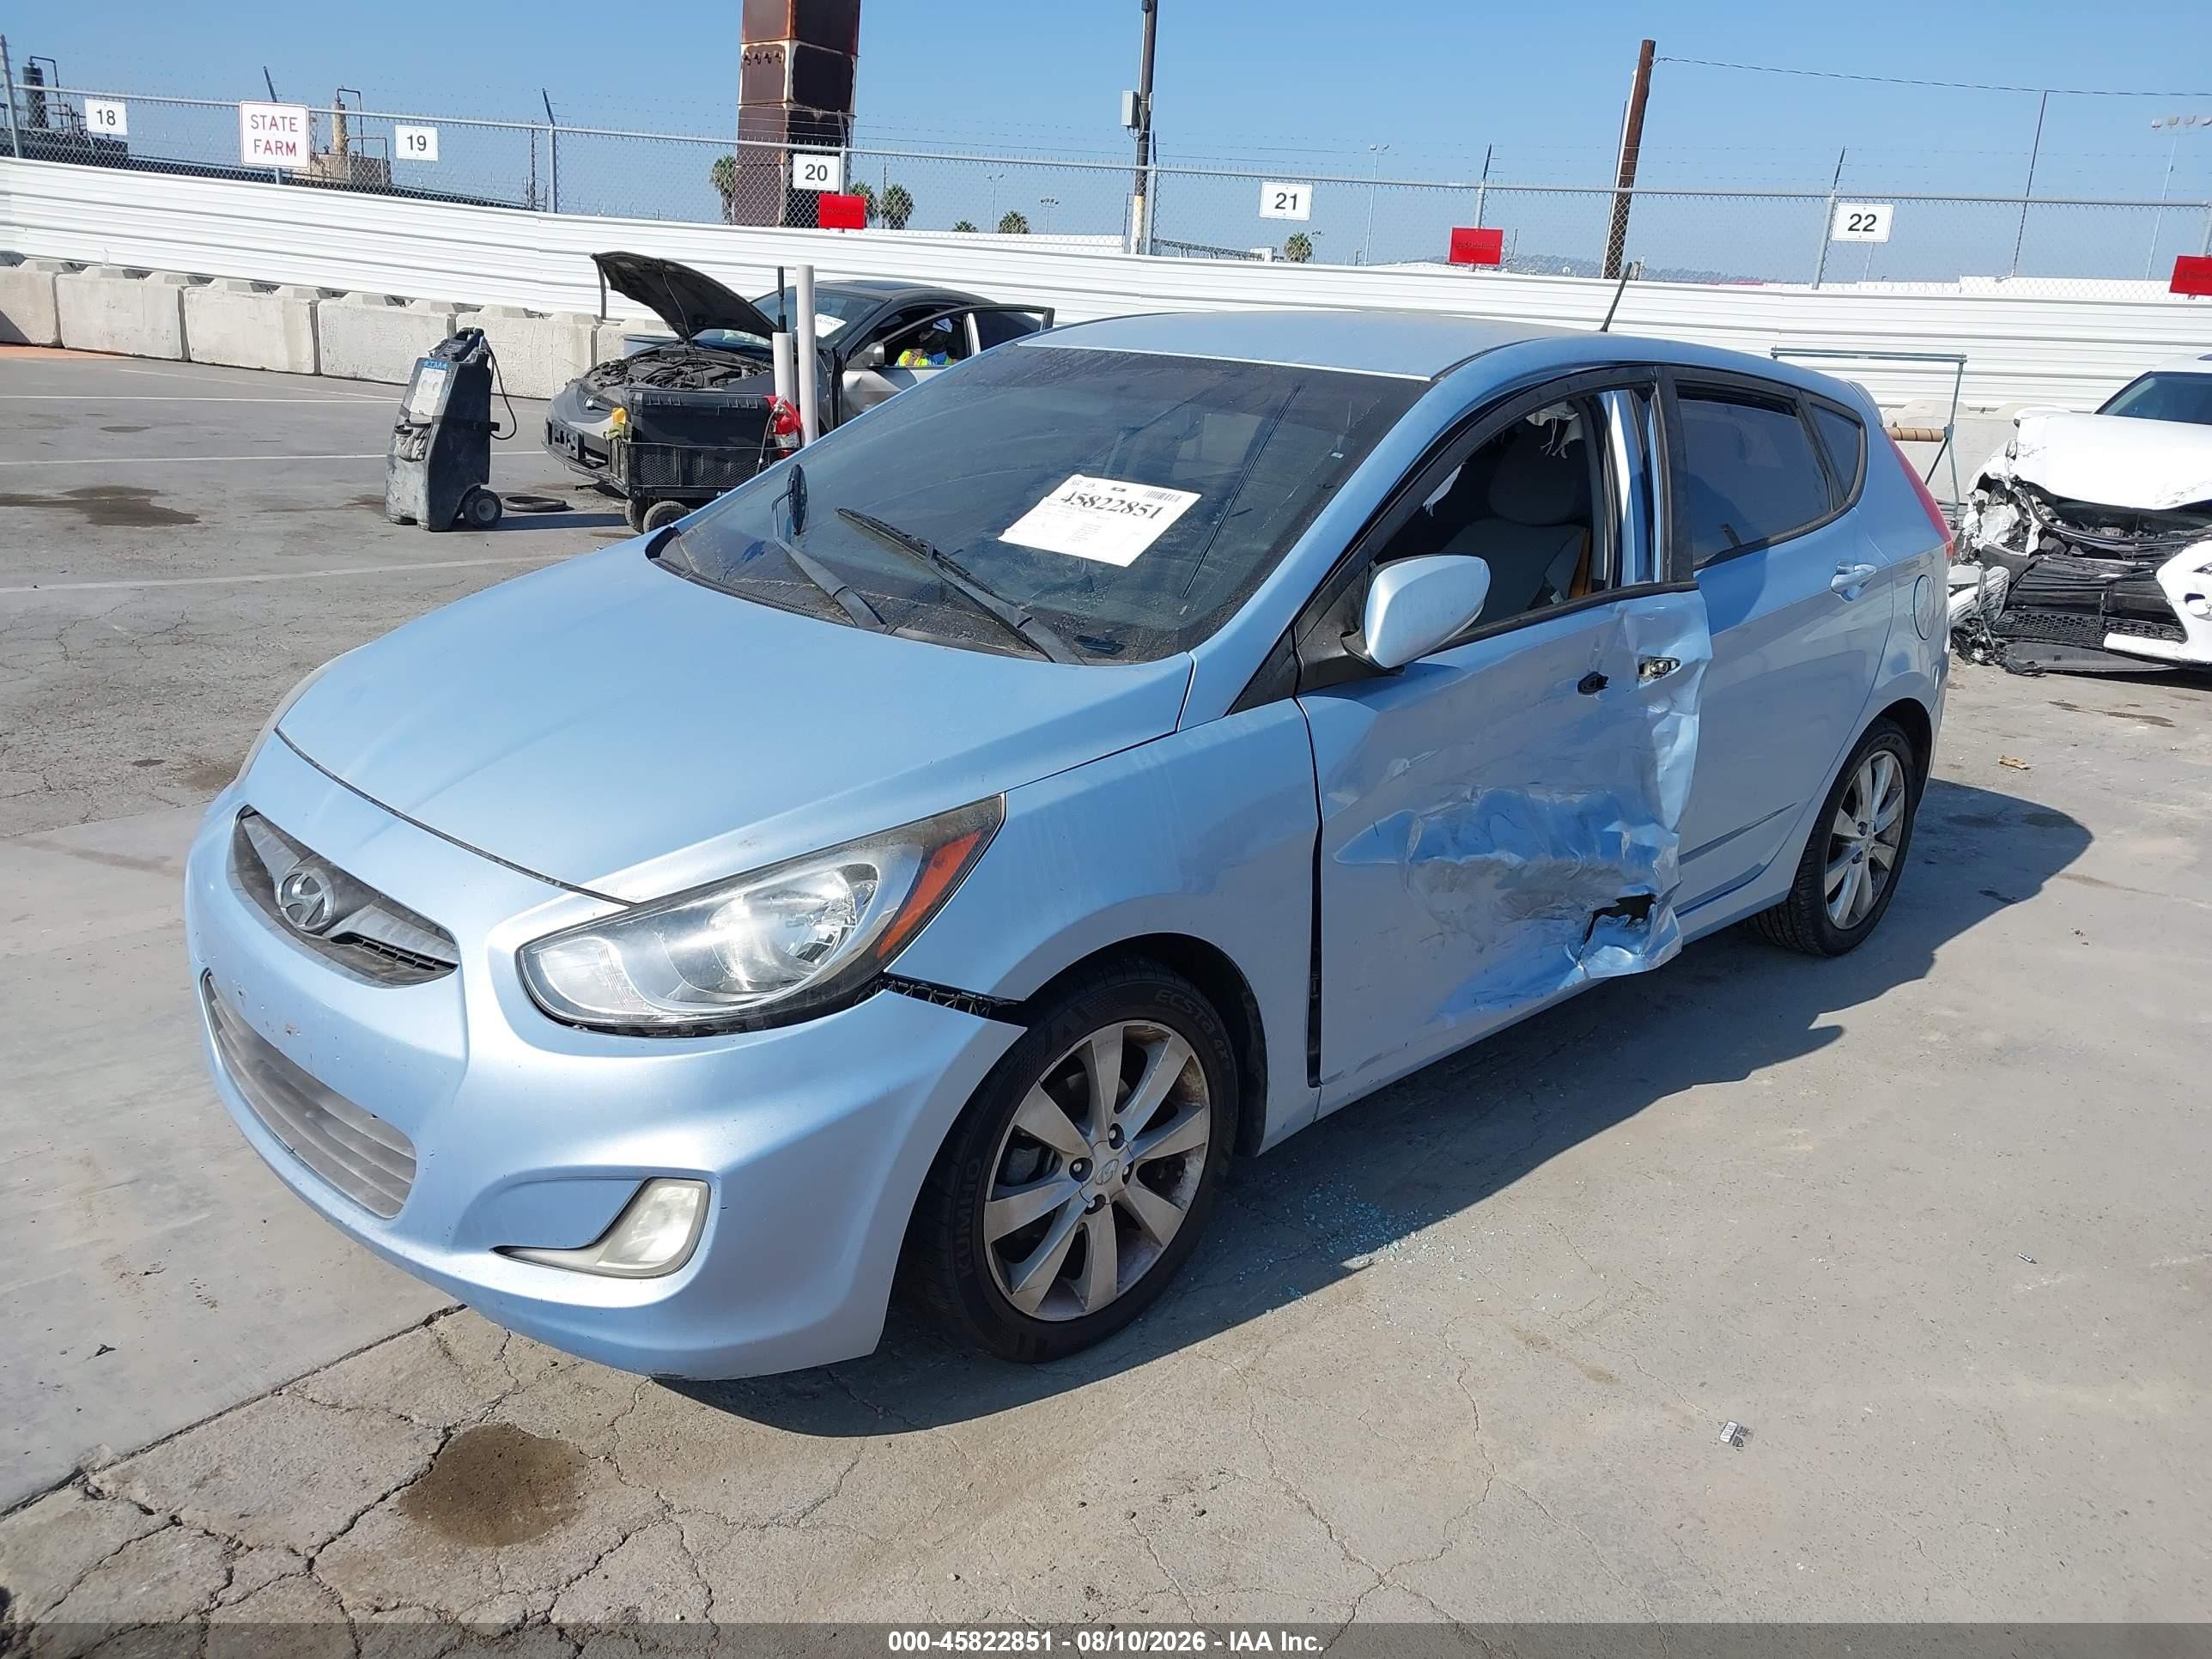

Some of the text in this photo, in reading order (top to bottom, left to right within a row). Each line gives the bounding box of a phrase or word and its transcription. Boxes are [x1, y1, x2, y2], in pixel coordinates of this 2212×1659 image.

[96, 109, 116, 126] 18
[250, 113, 299, 132] STATE
[253, 138, 297, 157] FARM
[407, 135, 427, 152] 19
[805, 163, 828, 182] 20
[1274, 192, 1297, 210] 21
[1847, 213, 1877, 233] 22
[1060, 490, 1164, 520] 45822851
[955, 1158, 981, 1278] KUMHO
